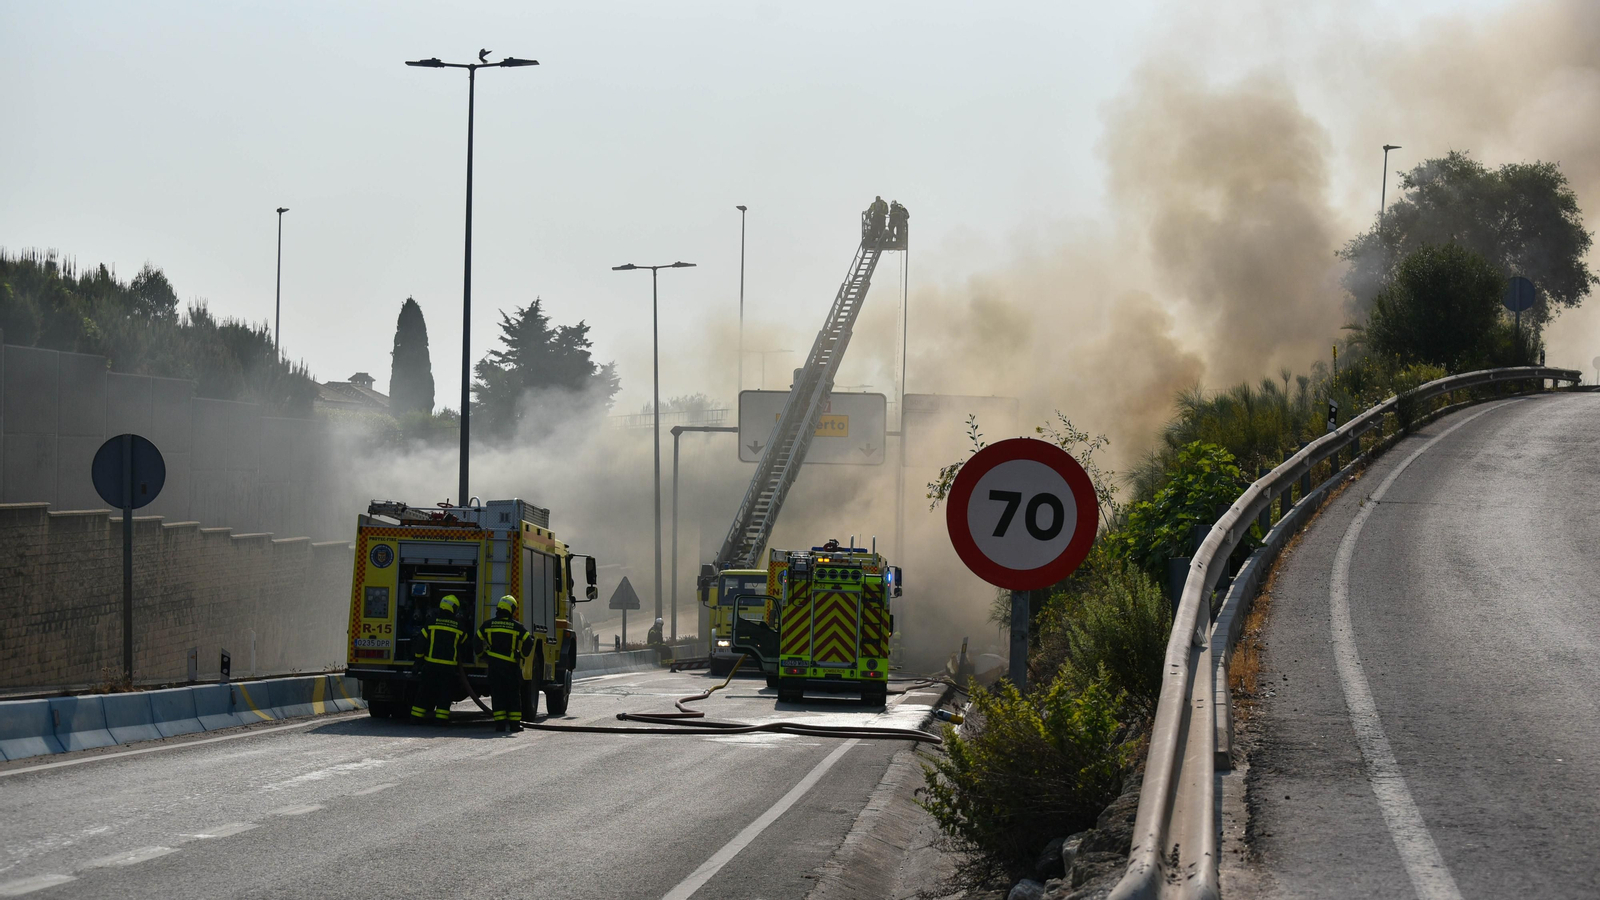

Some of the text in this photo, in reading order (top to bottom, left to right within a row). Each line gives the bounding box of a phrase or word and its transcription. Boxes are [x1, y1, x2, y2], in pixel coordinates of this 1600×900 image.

[989, 489, 1065, 541] 70
[363, 623, 392, 634] R-15
[357, 639, 375, 647] 0235
